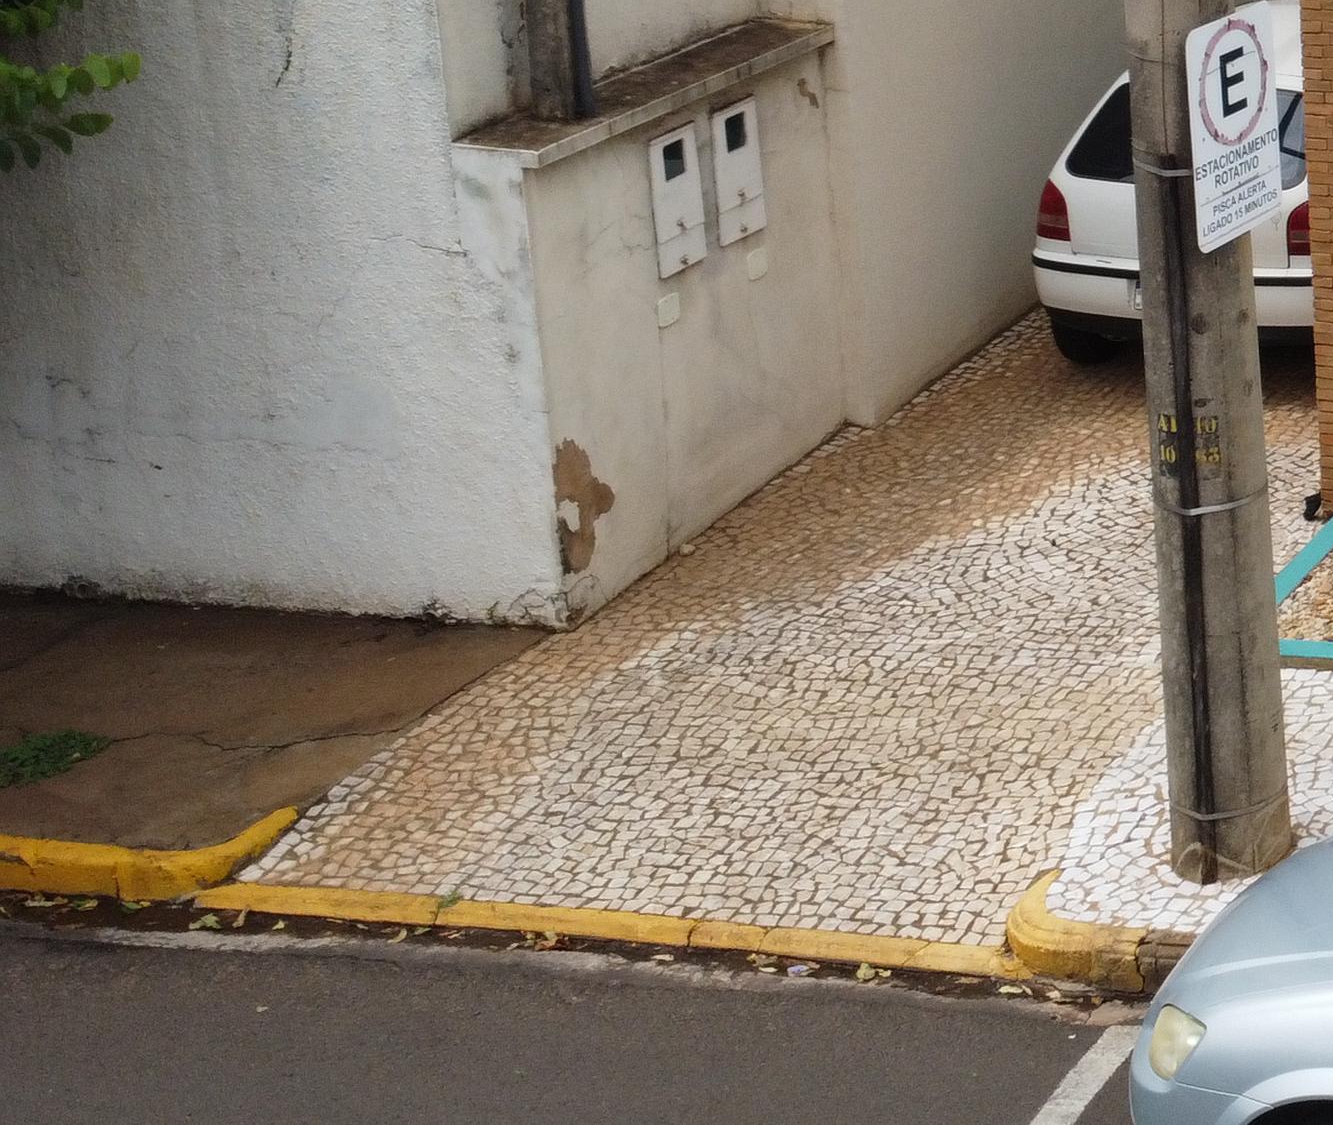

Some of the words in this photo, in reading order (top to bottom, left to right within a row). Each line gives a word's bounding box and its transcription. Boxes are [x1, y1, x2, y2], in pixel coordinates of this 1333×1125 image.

[1219, 46, 1248, 118] E
[1195, 128, 1277, 181] ESTACIONAMENTO
[1214, 156, 1259, 188] ROTATIVO
[1203, 213, 1232, 237] LIGADO
[1235, 208, 1243, 220] 15
[1244, 188, 1277, 215] MINUTOS
[1213, 196, 1236, 216] PISCA
[1238, 180, 1267, 201] ALERTA
